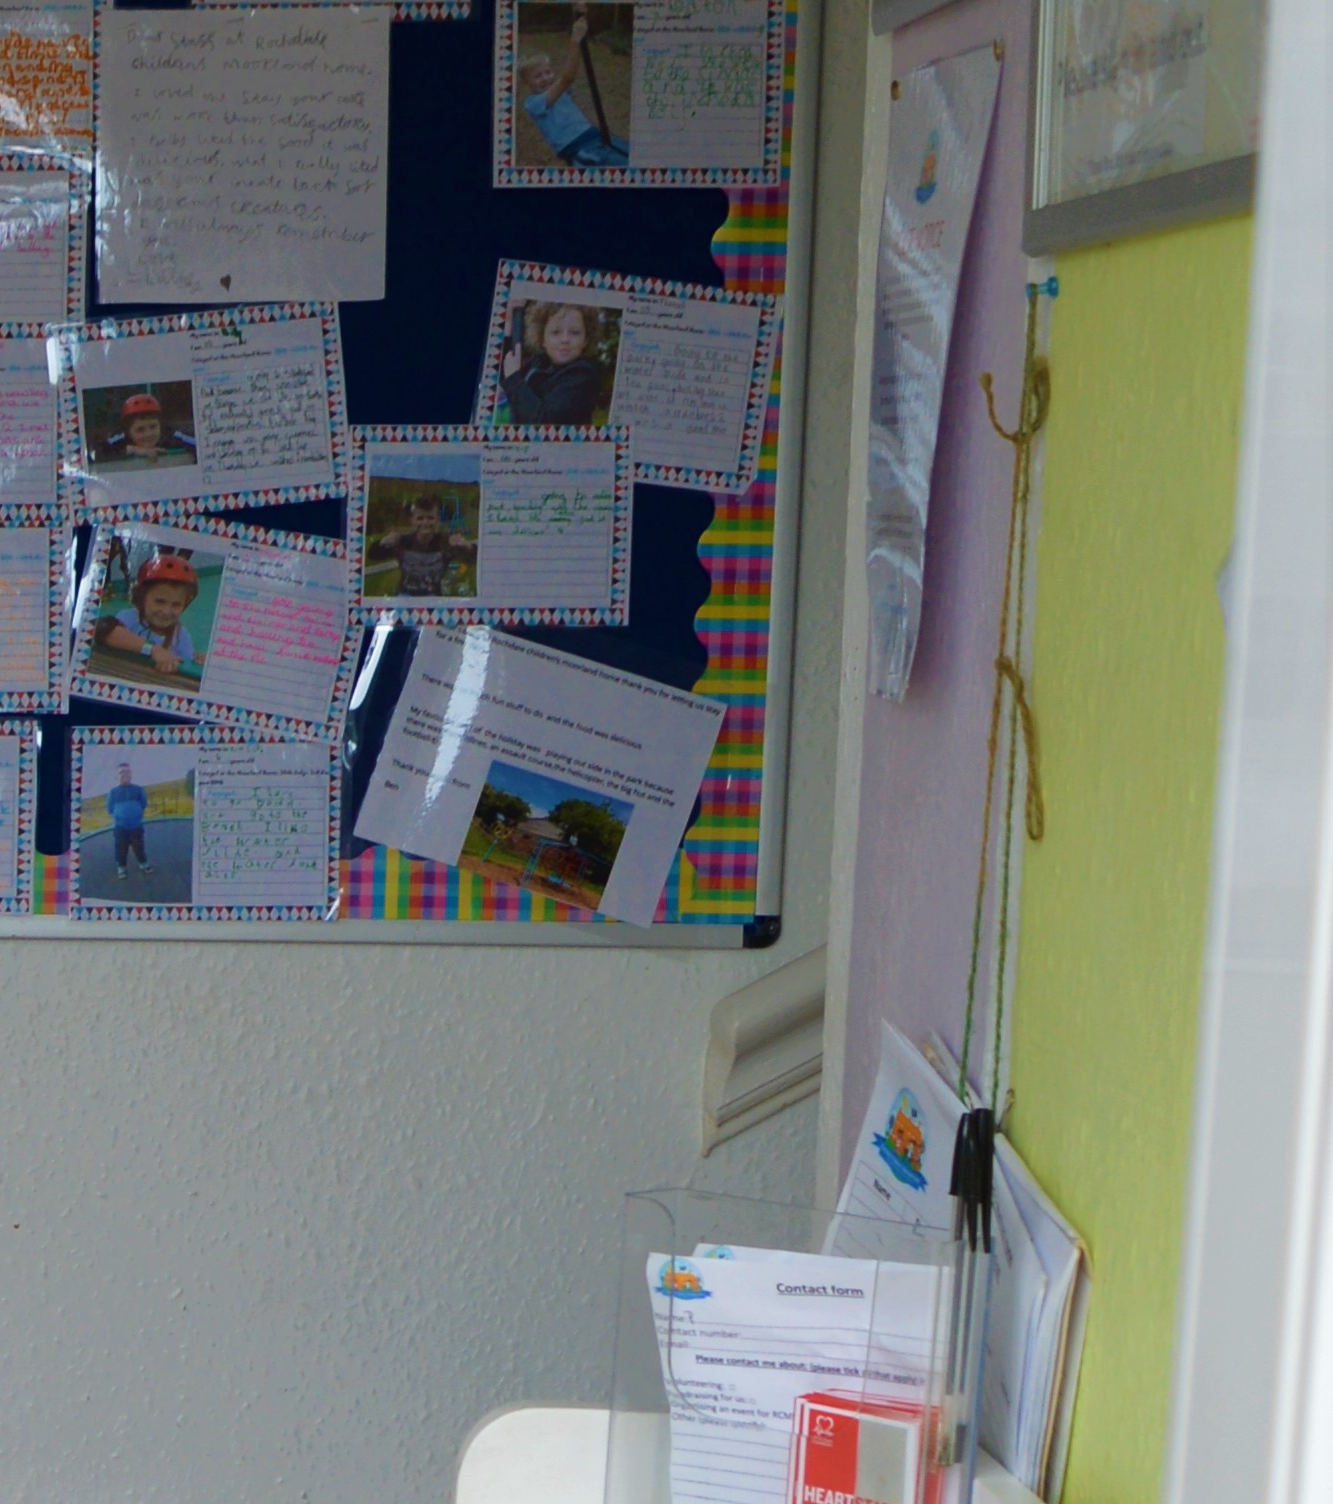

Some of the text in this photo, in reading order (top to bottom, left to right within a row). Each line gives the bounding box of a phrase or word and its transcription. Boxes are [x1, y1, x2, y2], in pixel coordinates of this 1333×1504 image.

[421, 674, 442, 687] There
[505, 700, 524, 712] stuff
[546, 713, 561, 724] and
[545, 749, 572, 765] playing
[587, 762, 603, 773] side
[625, 774, 643, 787] park
[643, 780, 675, 796] because
[776, 1282, 864, 1297] Contact form
[695, 1354, 723, 1364] Please
[727, 1357, 759, 1366] contact
